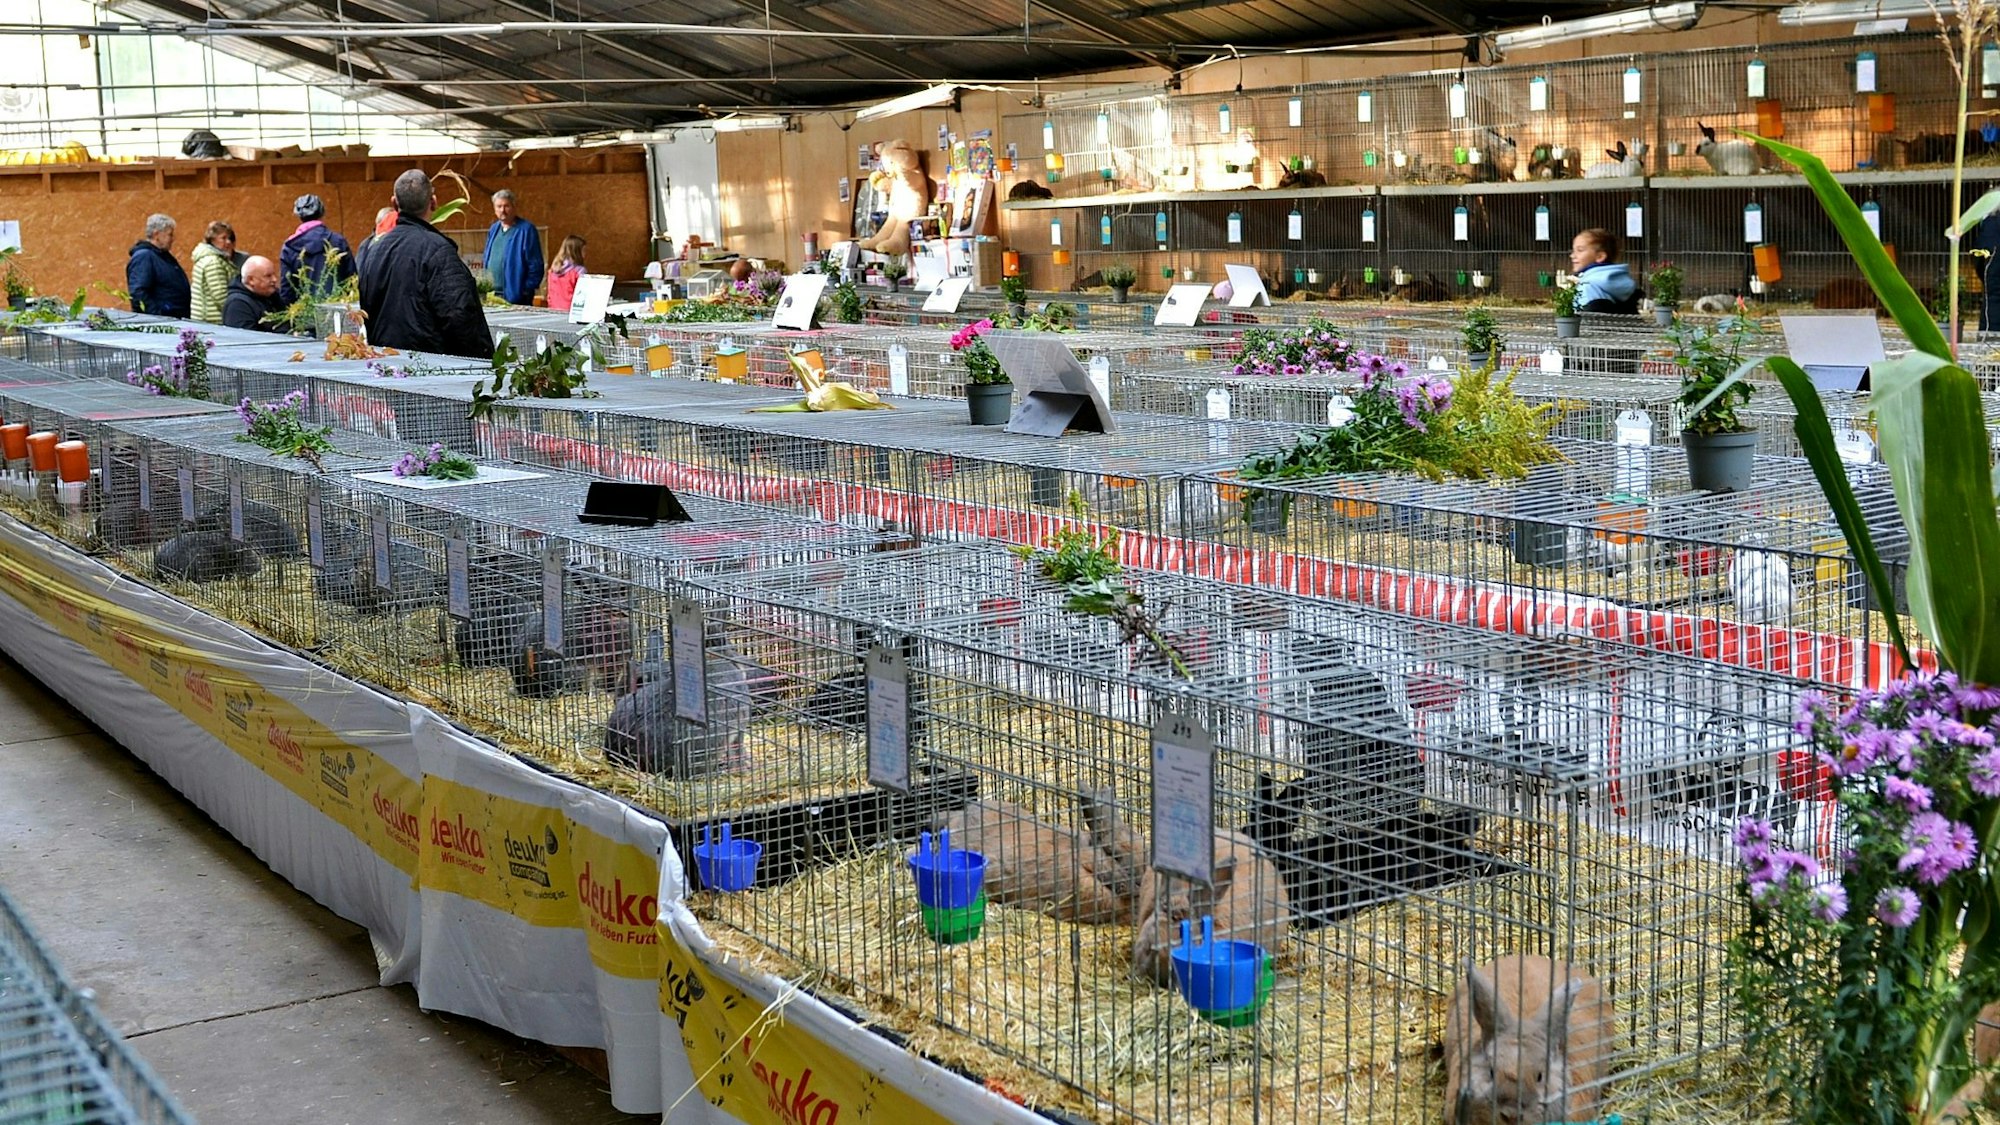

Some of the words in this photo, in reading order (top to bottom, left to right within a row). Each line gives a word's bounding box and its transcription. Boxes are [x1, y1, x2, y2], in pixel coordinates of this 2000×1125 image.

[320, 747, 348, 783] deuka
[373, 784, 420, 842] deuka
[431, 806, 485, 859] deuka
[504, 829, 547, 868] deuka
